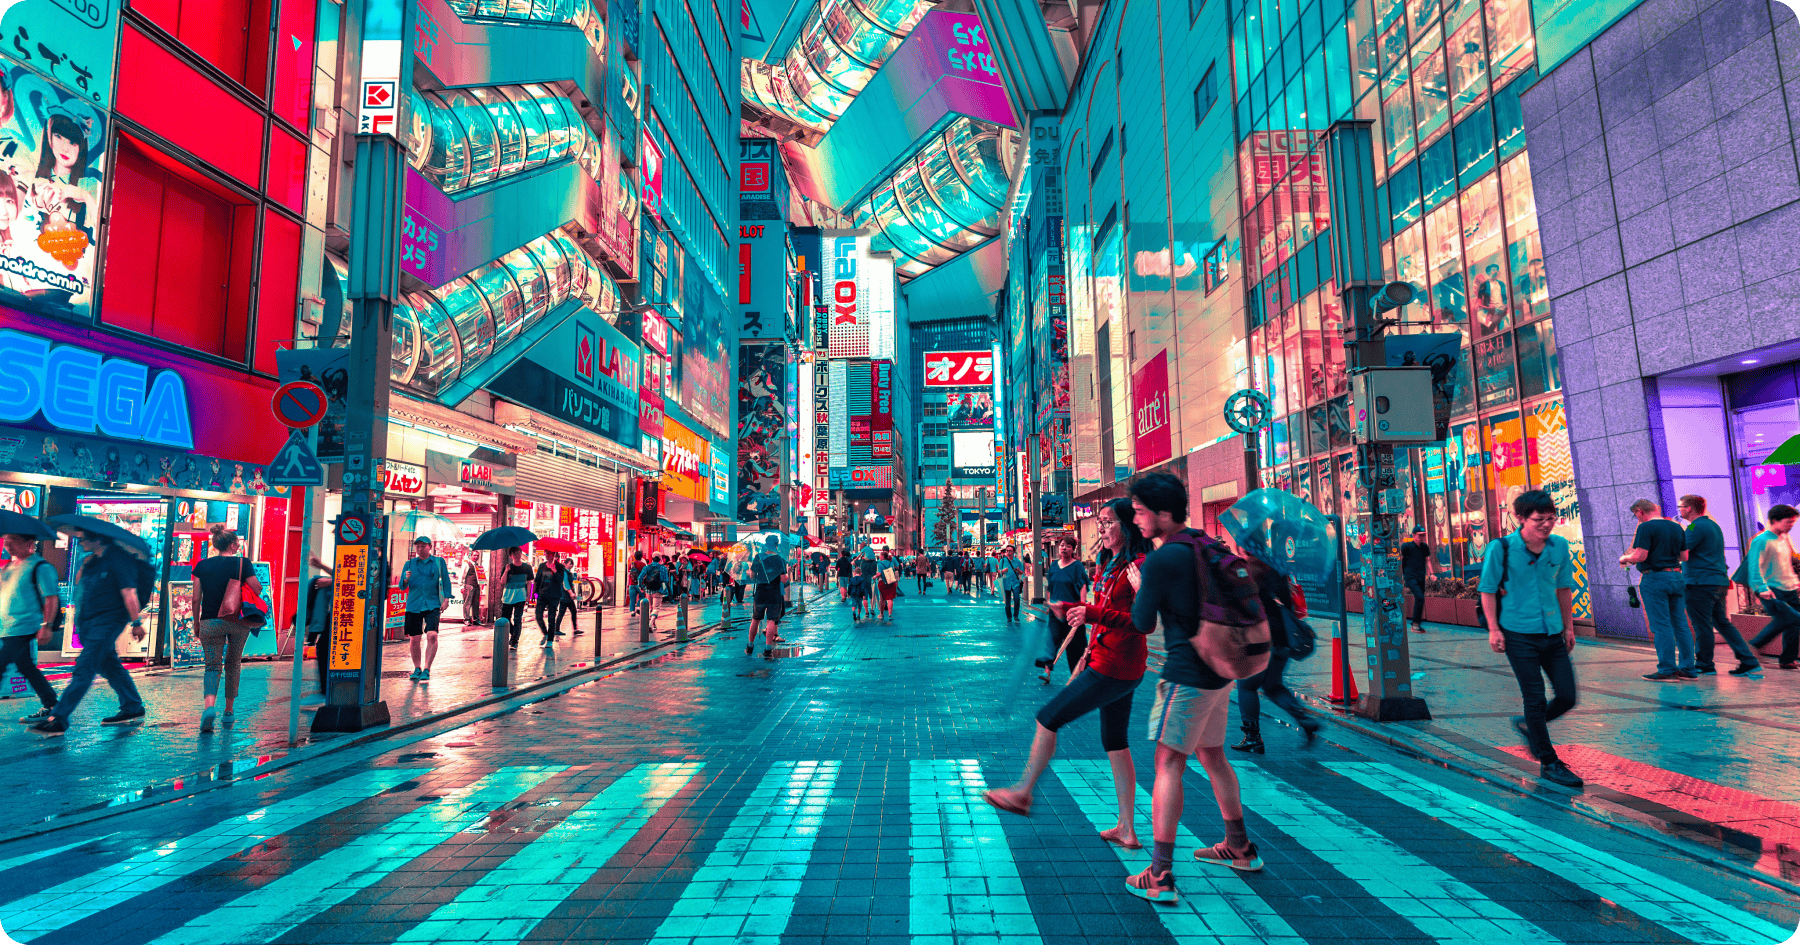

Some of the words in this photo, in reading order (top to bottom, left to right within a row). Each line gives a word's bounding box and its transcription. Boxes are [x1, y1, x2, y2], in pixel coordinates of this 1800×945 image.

[403, 215, 439, 252] カメラ
[598, 336, 638, 394] LABI
[0, 328, 195, 450] SEGA
[597, 378, 638, 413] AKIHABARA
[1138, 390, 1161, 434] atré
[471, 464, 493, 480] LABI
[338, 553, 358, 666] 路上喫煙禁止です。
[390, 592, 407, 605] au
